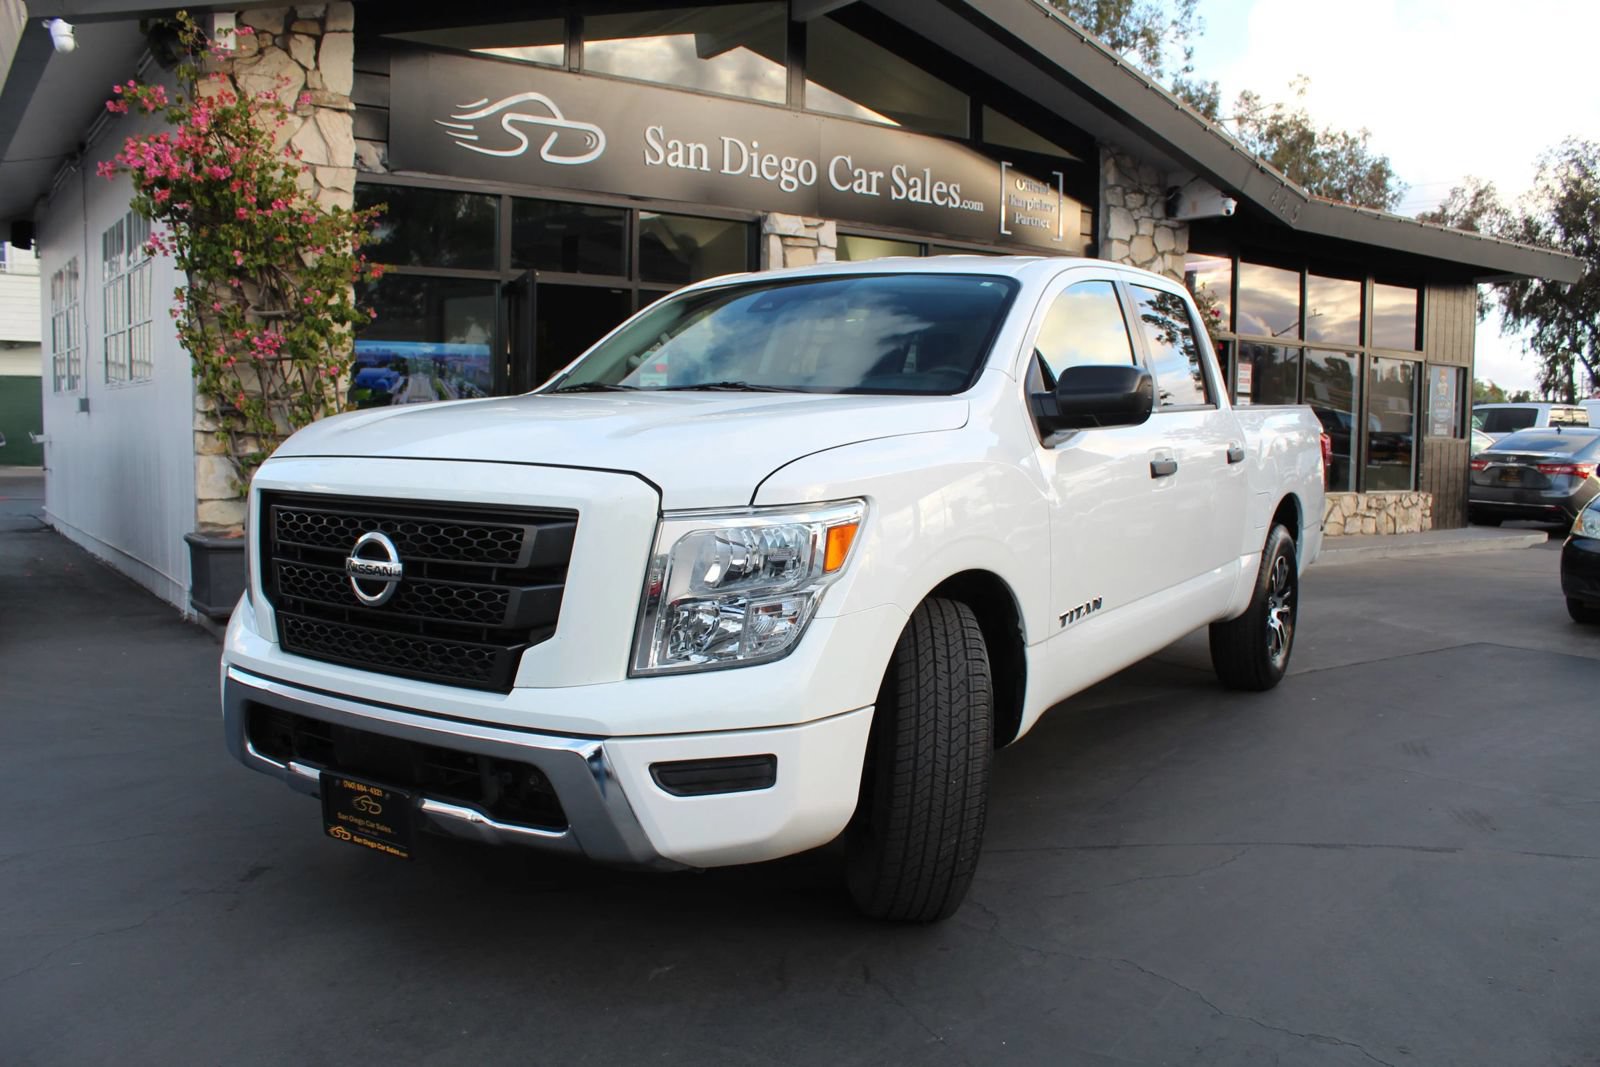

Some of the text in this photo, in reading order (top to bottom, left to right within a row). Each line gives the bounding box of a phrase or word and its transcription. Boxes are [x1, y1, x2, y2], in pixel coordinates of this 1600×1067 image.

[644, 125, 984, 212] San Diego Car Sales.com
[346, 563, 393, 577] NISSAN
[1059, 597, 1103, 628] TITAN
